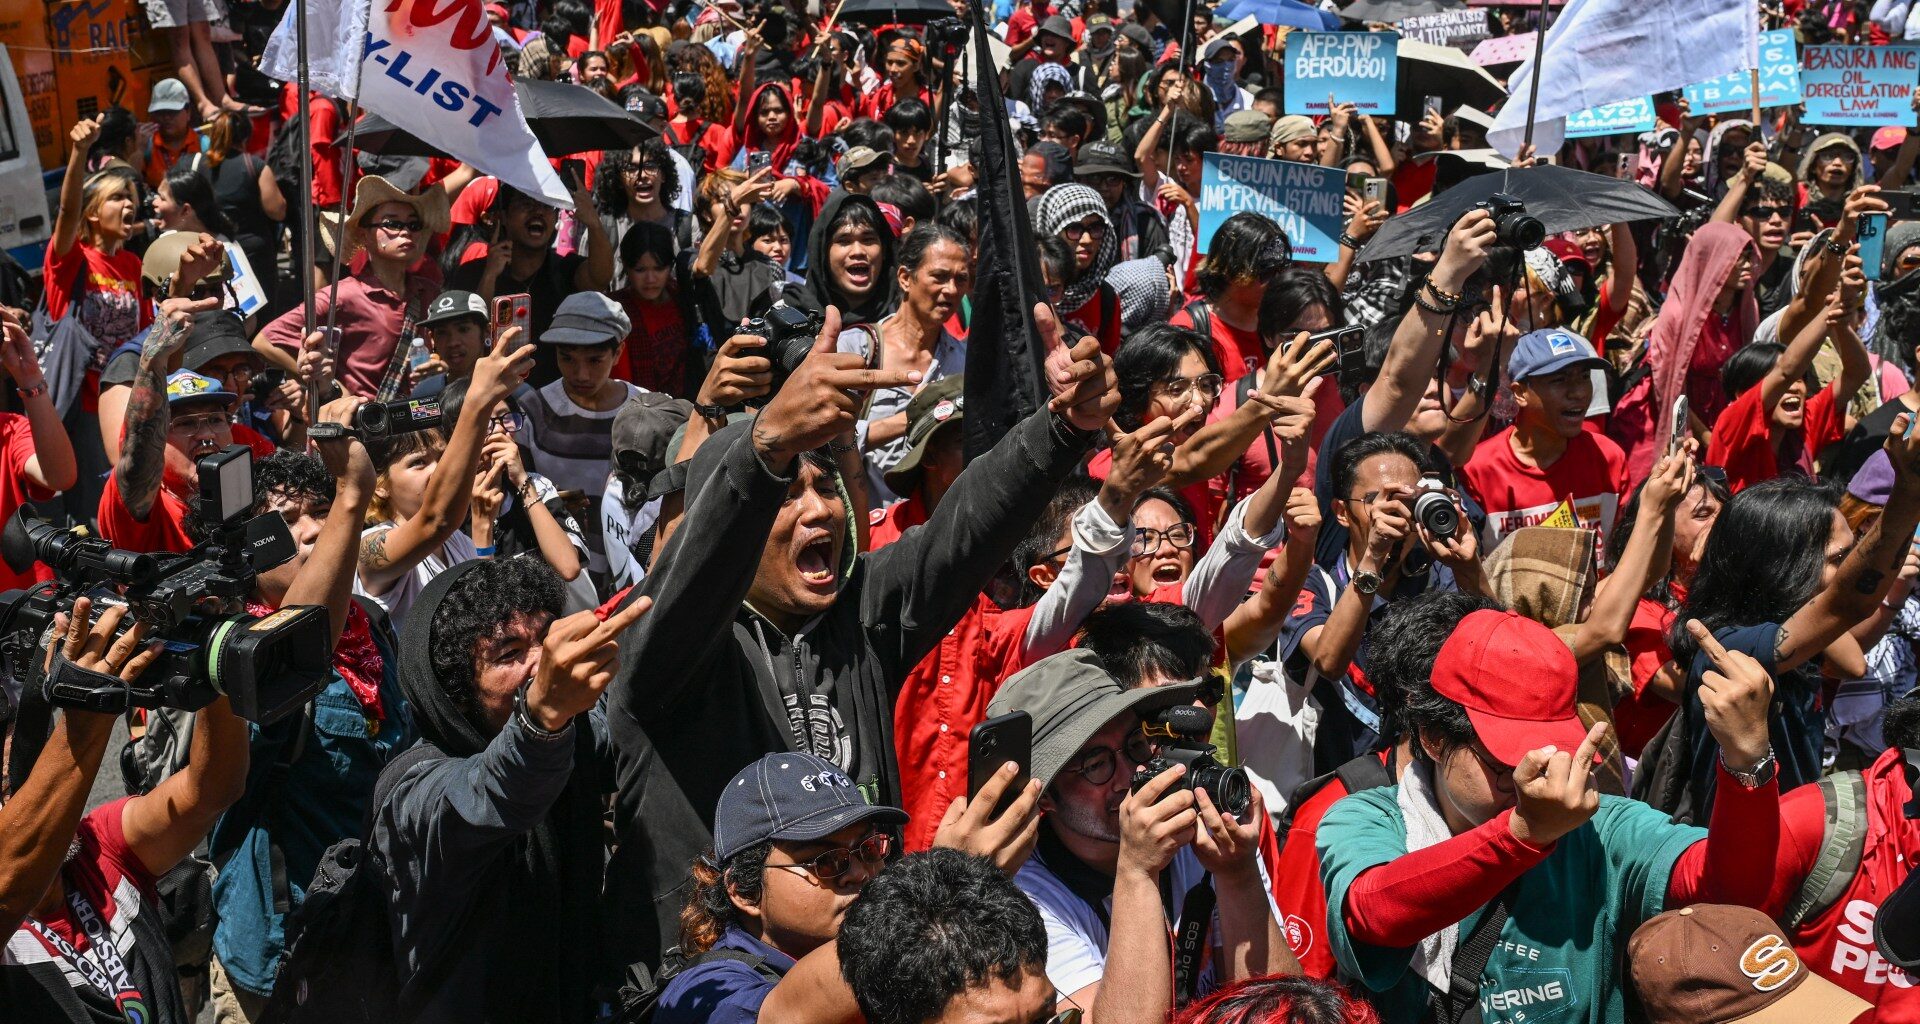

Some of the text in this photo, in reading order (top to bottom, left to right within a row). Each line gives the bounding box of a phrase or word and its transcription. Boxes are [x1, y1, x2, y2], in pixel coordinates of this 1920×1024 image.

[1301, 34, 1381, 58] AFP-PNP
[1296, 57, 1386, 81] BERDUGO!
[1882, 50, 1916, 70] ANG
[1842, 70, 1872, 84] OIL
[1806, 83, 1910, 98] DEREGULATION
[1218, 158, 1326, 188] BIGUIN ANG
[1202, 184, 1340, 217] IMPERYALISTANG
[1740, 935, 1800, 992] S
